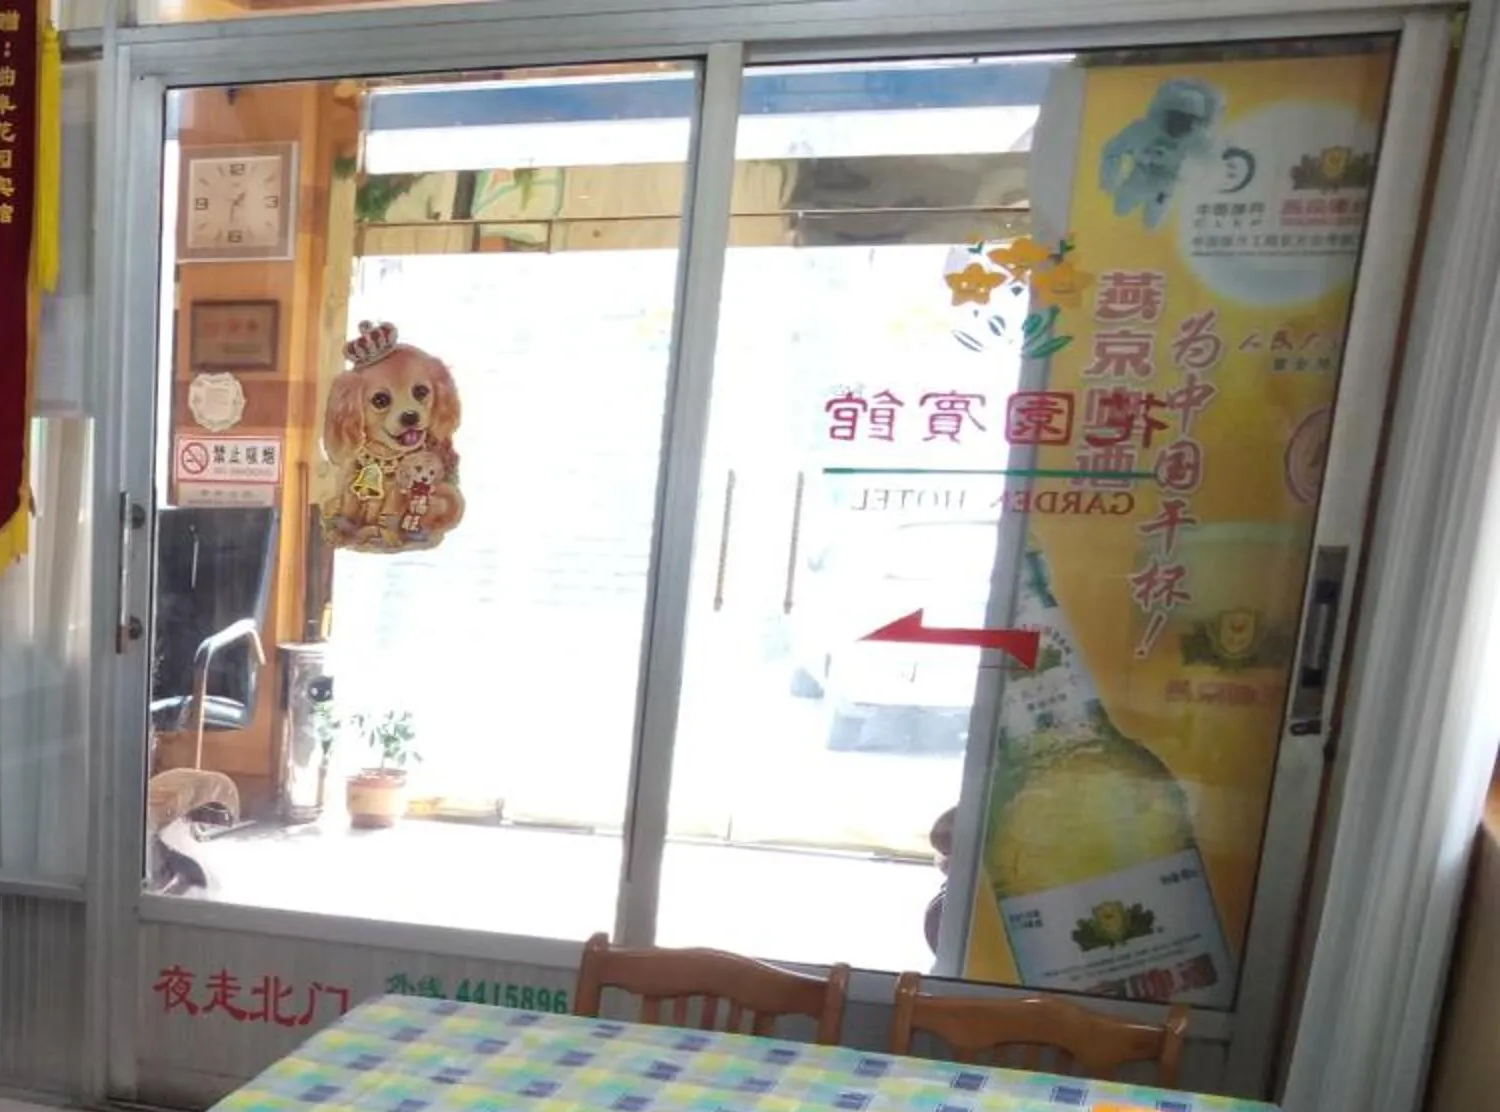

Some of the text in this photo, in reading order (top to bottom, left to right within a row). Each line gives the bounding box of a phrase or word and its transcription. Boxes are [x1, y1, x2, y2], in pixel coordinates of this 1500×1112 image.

[152, 964, 349, 1027] 夜走北门
[455, 977, 568, 1014] 4415896
